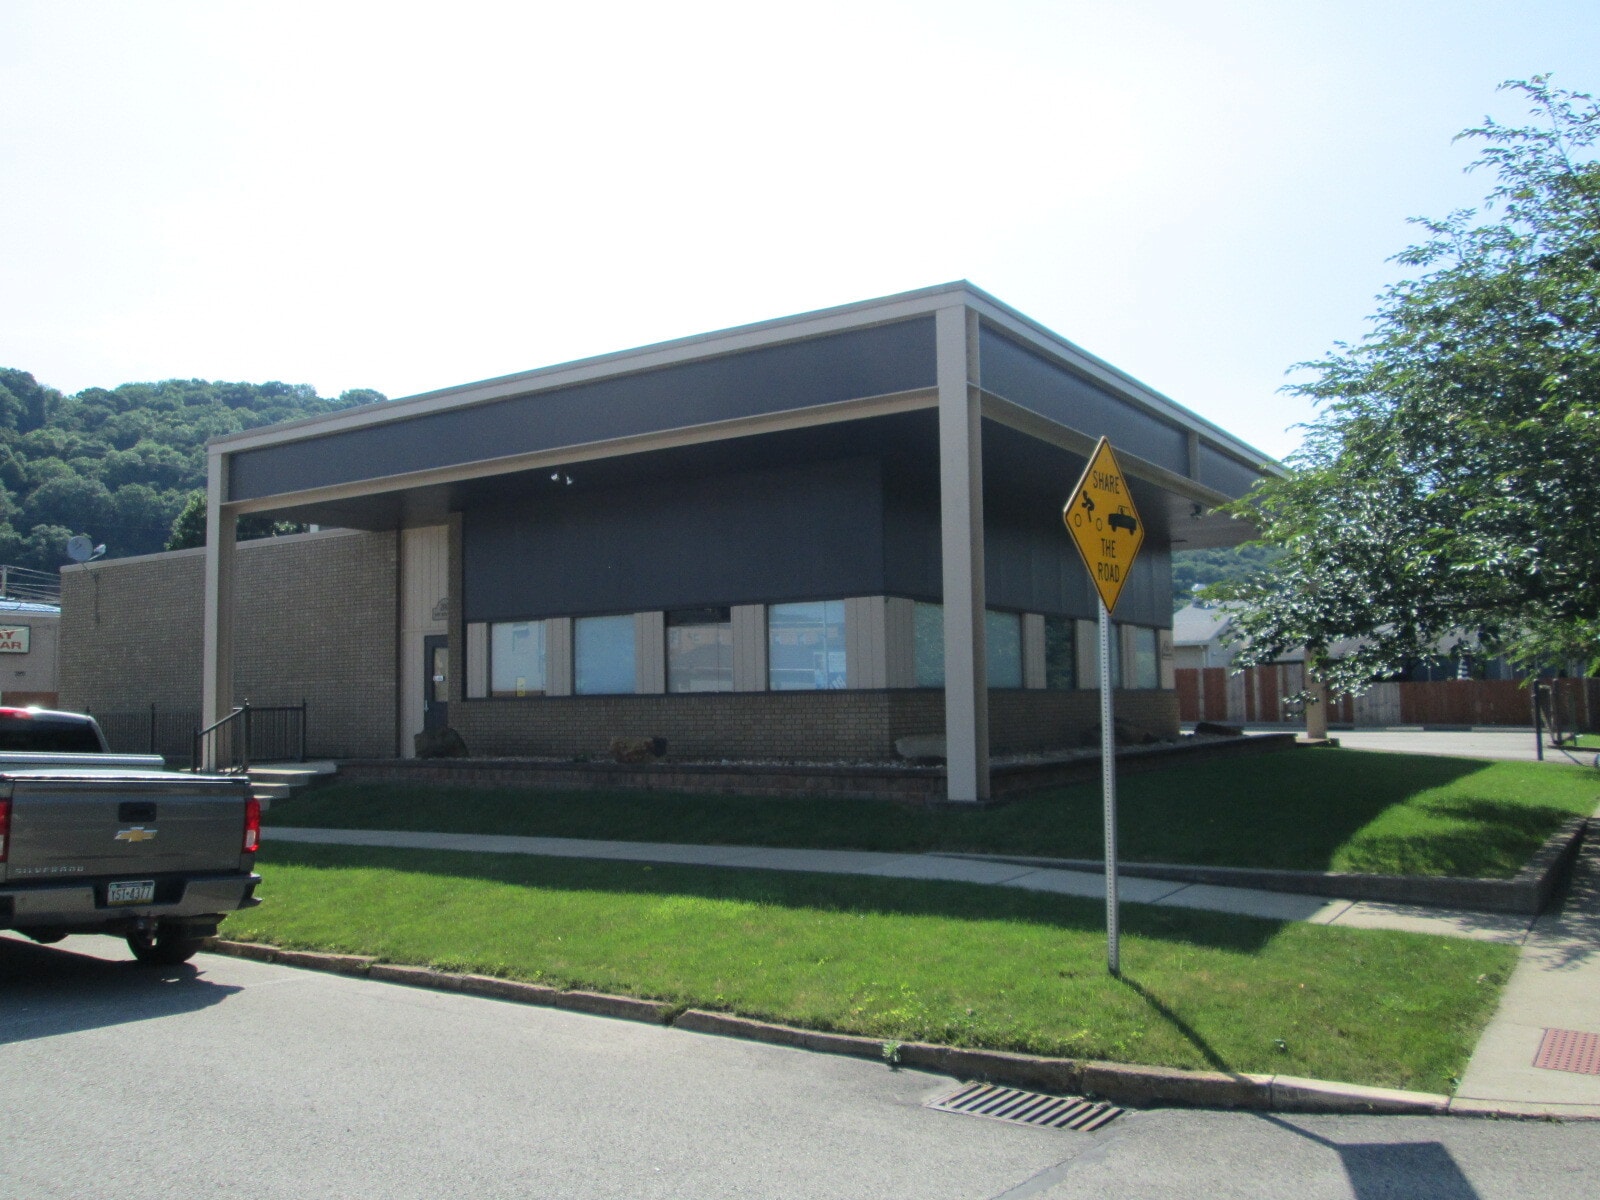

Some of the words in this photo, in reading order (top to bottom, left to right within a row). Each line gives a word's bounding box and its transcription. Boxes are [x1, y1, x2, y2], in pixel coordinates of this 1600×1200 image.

[1093, 471, 1120, 494] SHARE
[1101, 538, 1116, 558] THE
[1097, 562, 1120, 583] ROAD
